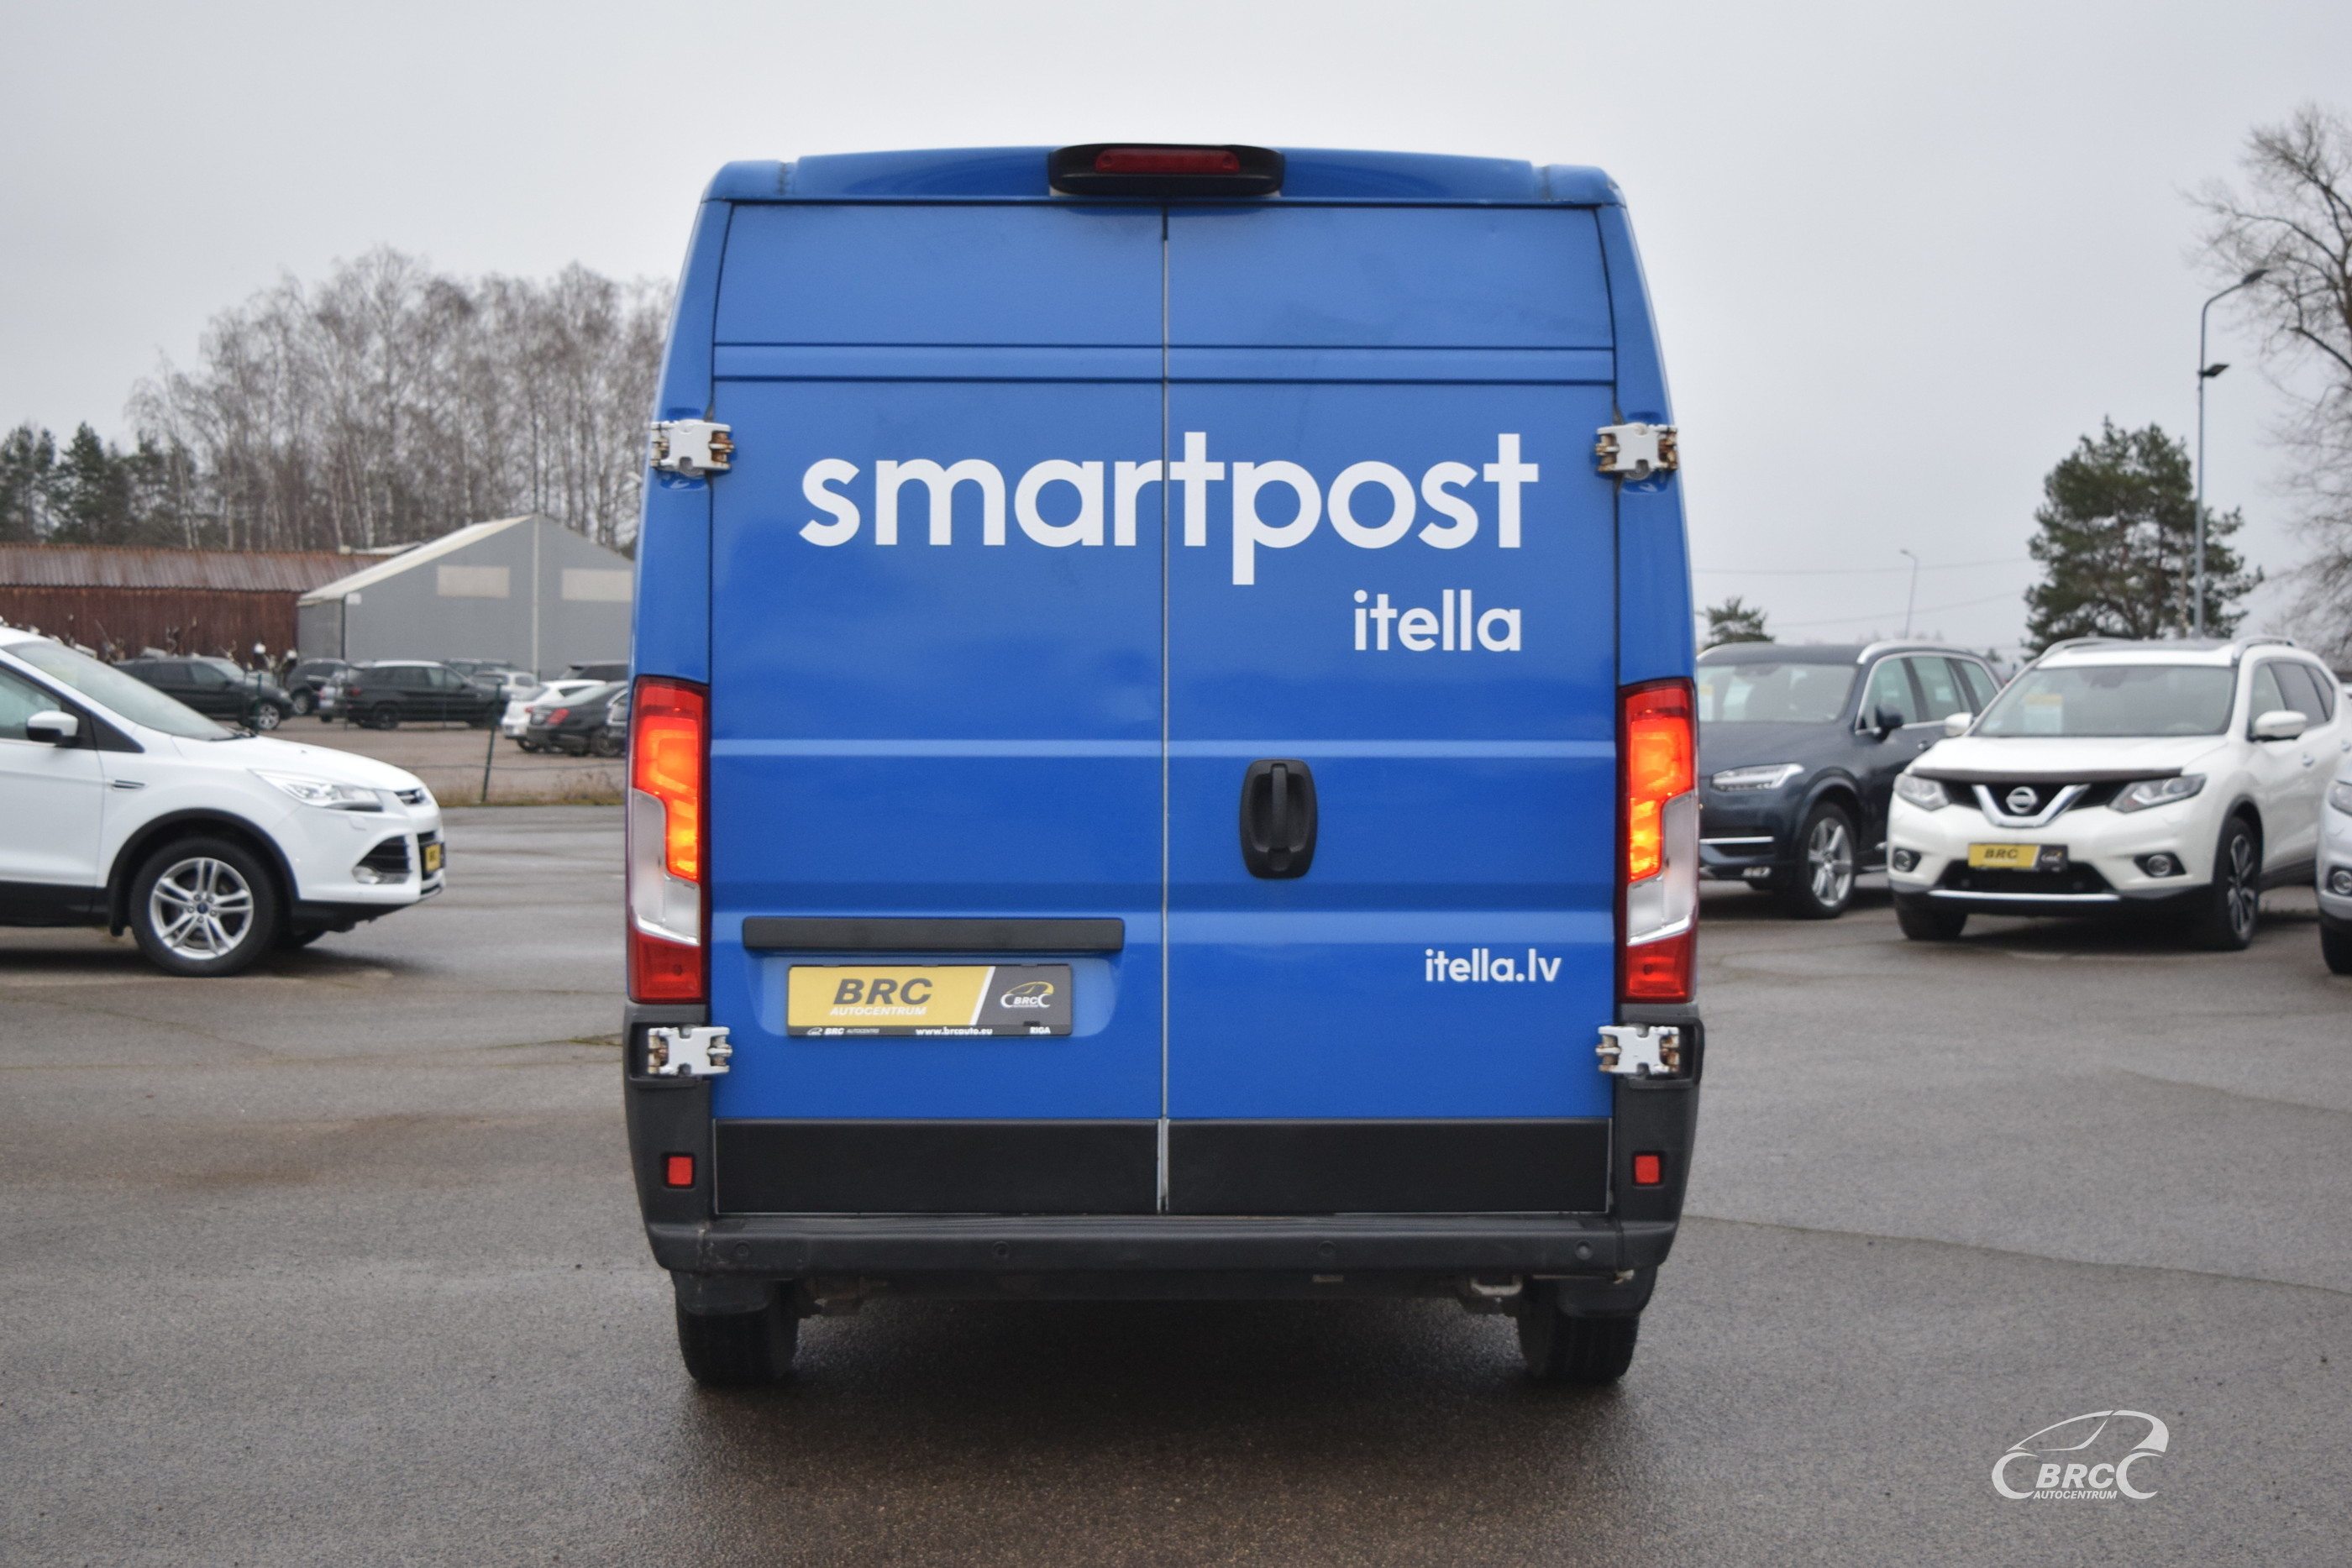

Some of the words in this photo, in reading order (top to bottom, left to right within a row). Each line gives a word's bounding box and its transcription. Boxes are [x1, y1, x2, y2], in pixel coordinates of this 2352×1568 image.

[800, 432, 1539, 585] smartpost
[1353, 590, 1521, 652] itella
[1984, 848, 2019, 858] BRC
[1425, 948, 1562, 983] itella.lv
[833, 978, 933, 1004] BRC
[830, 1006, 927, 1016] AUTOCENTRUM
[916, 1026, 993, 1035] www.brcauto.eu
